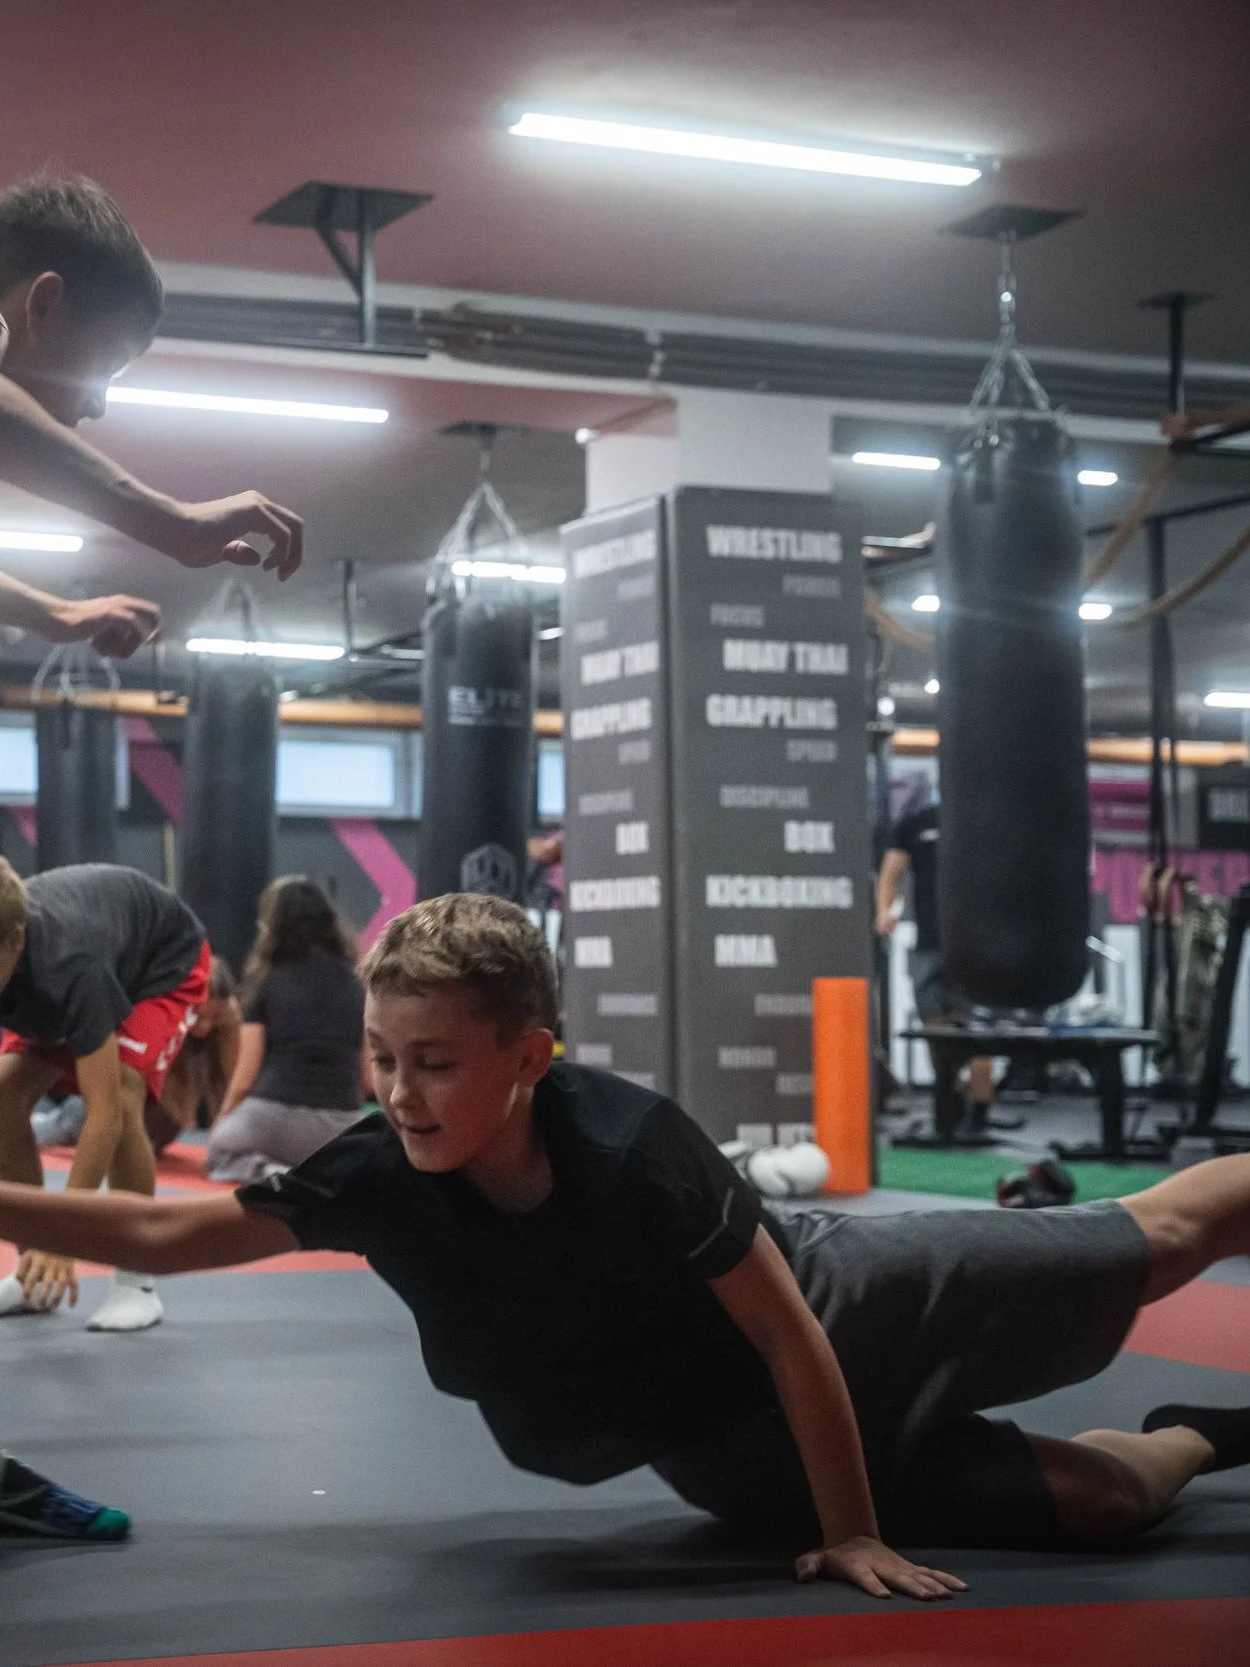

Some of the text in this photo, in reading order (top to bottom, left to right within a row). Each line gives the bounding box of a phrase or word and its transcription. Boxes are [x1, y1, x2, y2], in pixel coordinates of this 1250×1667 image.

[706, 524, 843, 564] WRESTLING
[723, 638, 848, 675] MUAY THAI
[706, 694, 838, 730] GRAPPLING
[784, 820, 835, 853] BOX
[706, 875, 853, 909] KICKBOXING
[714, 934, 778, 967] MMA
